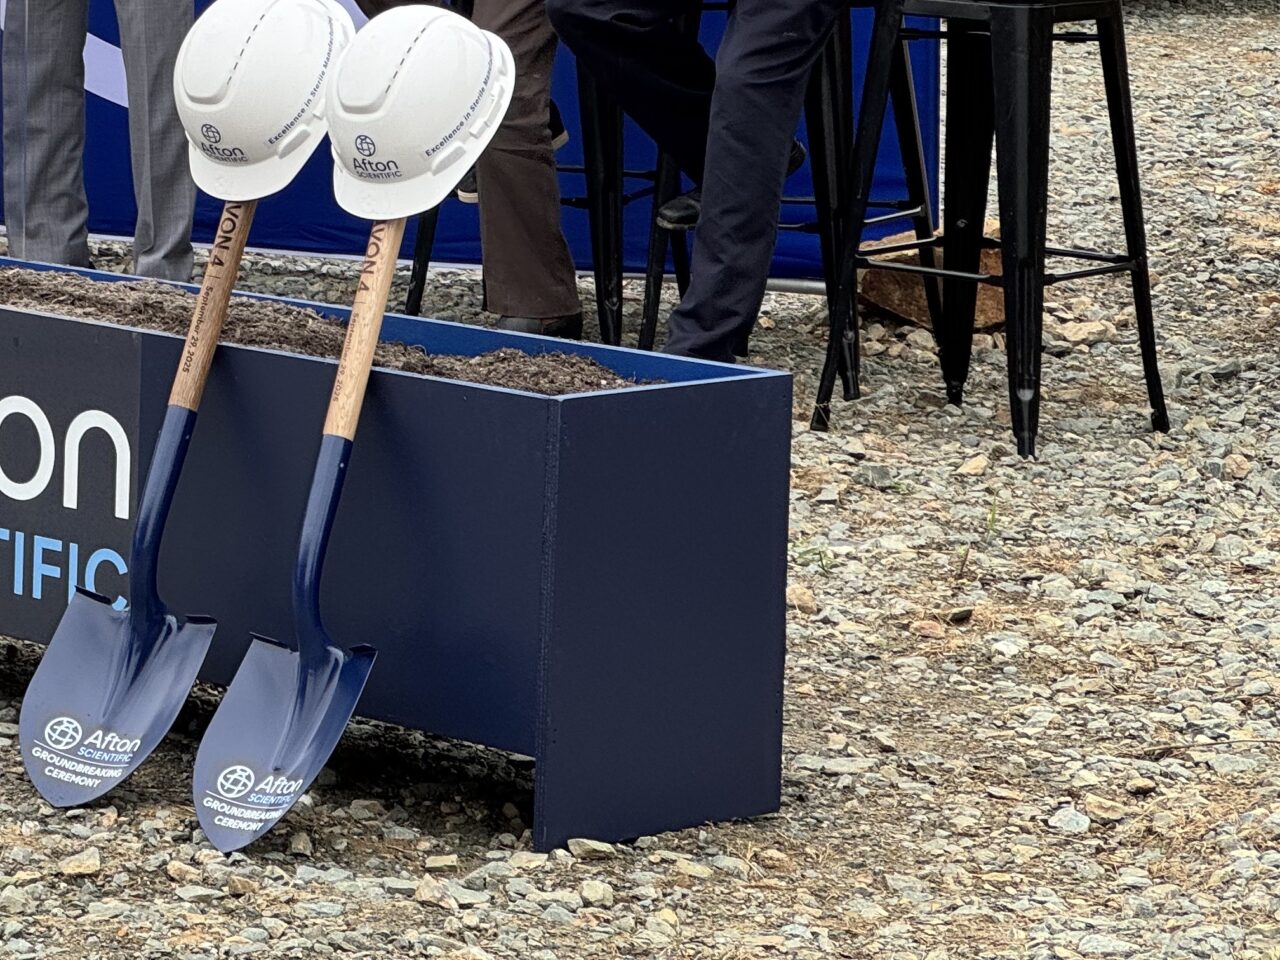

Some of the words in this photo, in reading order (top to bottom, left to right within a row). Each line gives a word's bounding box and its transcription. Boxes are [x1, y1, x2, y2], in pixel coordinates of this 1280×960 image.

[268, 108, 306, 145] Excellence
[304, 98, 312, 109] in
[310, 70, 326, 98] Sterile
[425, 121, 465, 157] Excellence
[464, 112, 471, 122] in
[470, 87, 486, 112] Sterile
[201, 142, 244, 157] Afton
[353, 158, 399, 172] Afton
[214, 201, 242, 251] VON
[211, 257, 224, 268] 4
[358, 283, 370, 293] 4
[192, 286, 214, 336] September
[188, 336, 199, 349] 29,
[343, 312, 359, 363] September
[182, 349, 195, 374] 2025
[332, 379, 345, 402] 2025
[84, 729, 141, 752] Afton
[32, 747, 123, 778] GROUNDBREAKING
[77, 746, 133, 762] SCIENTIFIC
[45, 766, 102, 788] CEREMONY
[254, 775, 304, 794] Afton
[214, 816, 264, 831] CEREMONY
